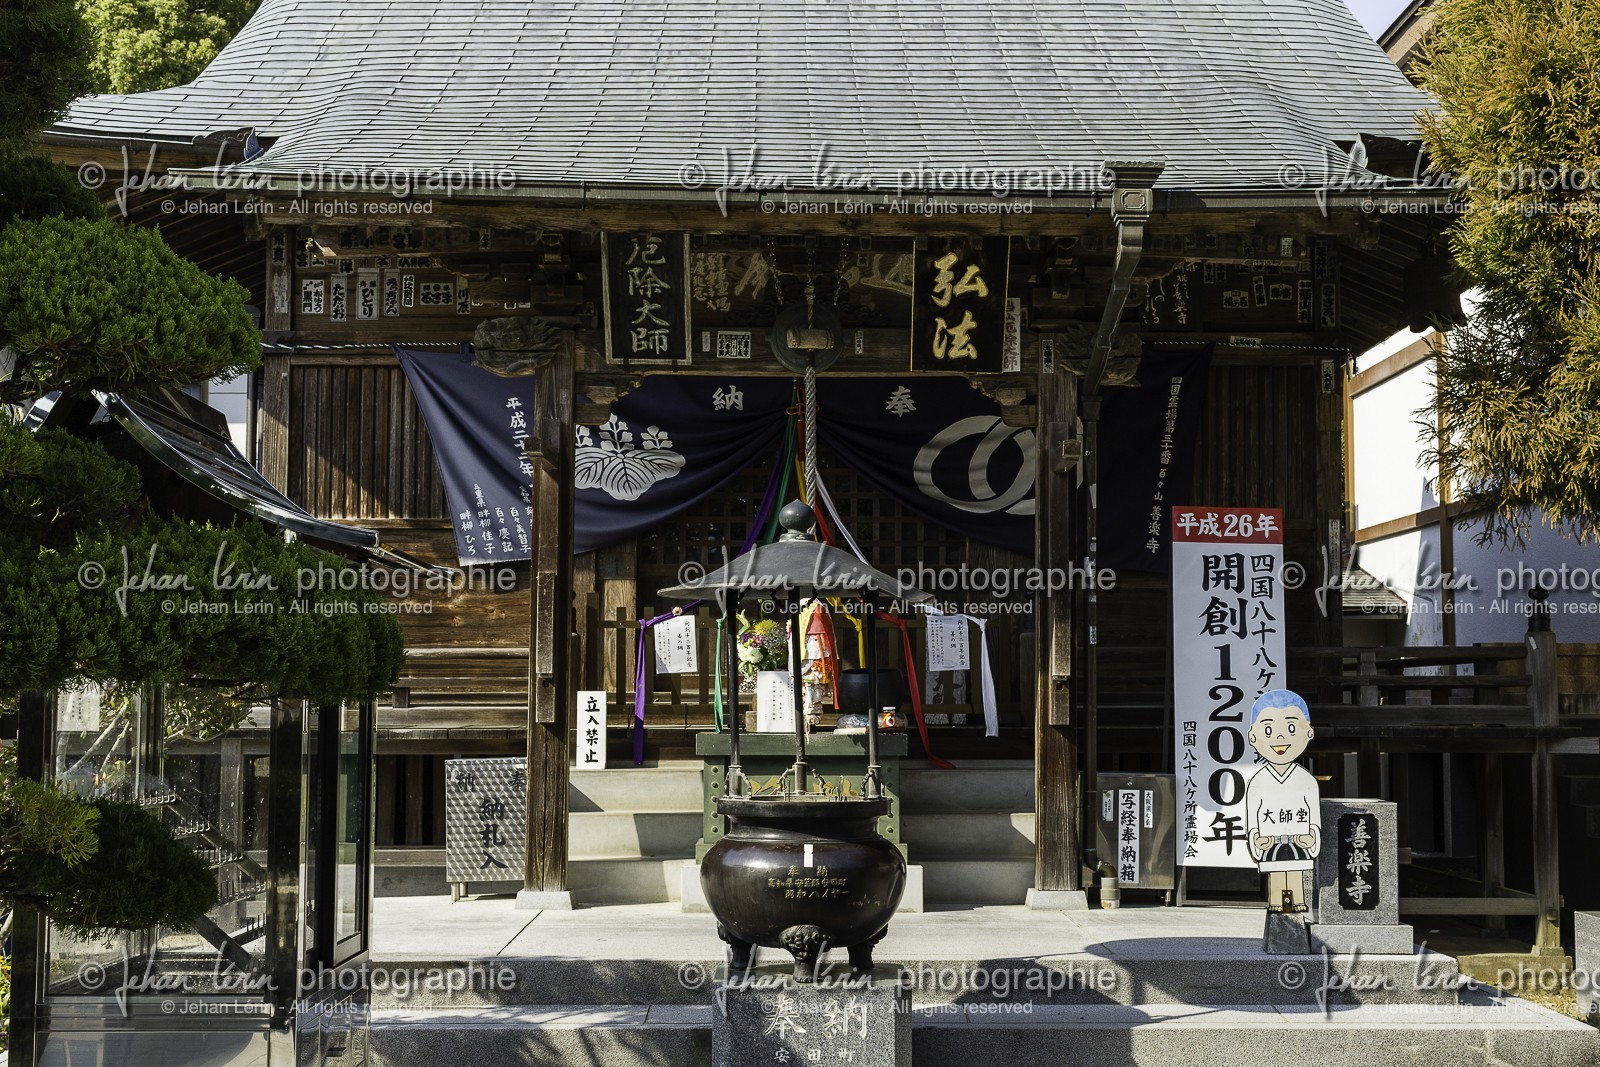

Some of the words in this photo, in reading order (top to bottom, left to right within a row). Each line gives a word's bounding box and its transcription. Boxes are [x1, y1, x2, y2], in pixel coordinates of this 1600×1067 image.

[930, 251, 989, 360] 弘法
[506, 397, 534, 488] 平成二十二年
[1176, 512, 1279, 539] 平成26年
[584, 696, 600, 764] 立入禁止
[1198, 552, 1249, 857] 開創1200年
[479, 797, 509, 870] 納札入
[1182, 720, 1199, 858] 四国八十八ケ所霊場会
[1263, 807, 1308, 825] 大師堂
[1120, 792, 1138, 882] 写経奉納箱
